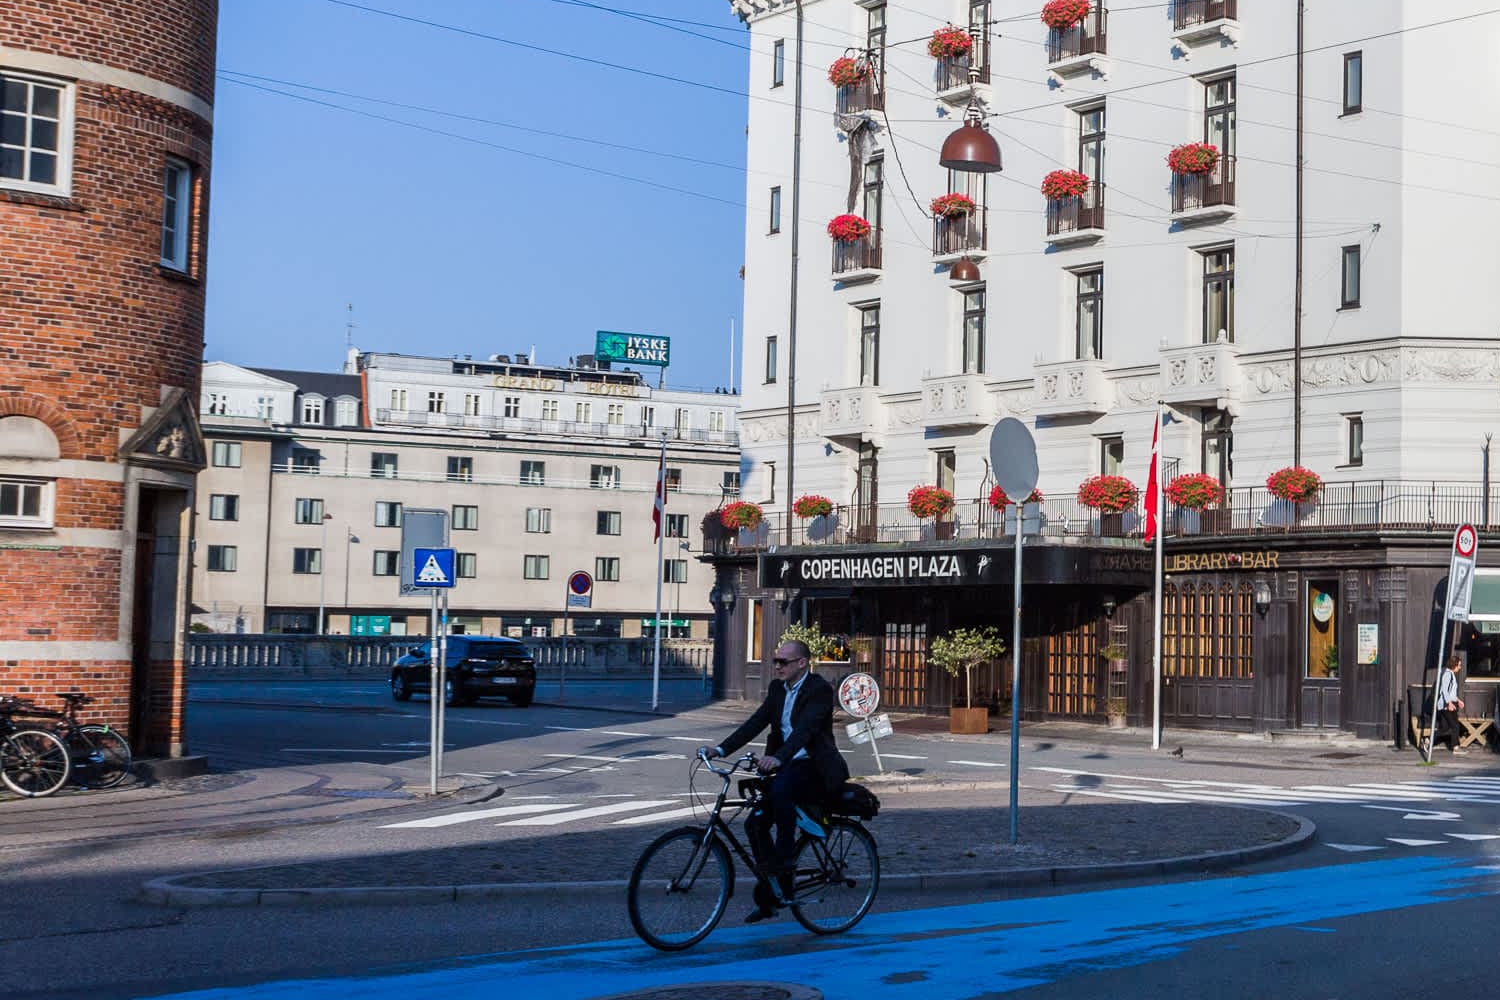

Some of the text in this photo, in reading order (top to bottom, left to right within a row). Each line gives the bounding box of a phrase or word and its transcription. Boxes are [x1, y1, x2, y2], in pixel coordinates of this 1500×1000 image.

[627, 336, 667, 350] JYSKE
[627, 349, 668, 362] BANK
[494, 375, 640, 398] GRAND HOTEL
[801, 557, 904, 580] COPENHAGEN
[908, 556, 961, 578] PLAZA
[1164, 553, 1230, 572] LIBRARY
[1241, 551, 1280, 569] BAR
